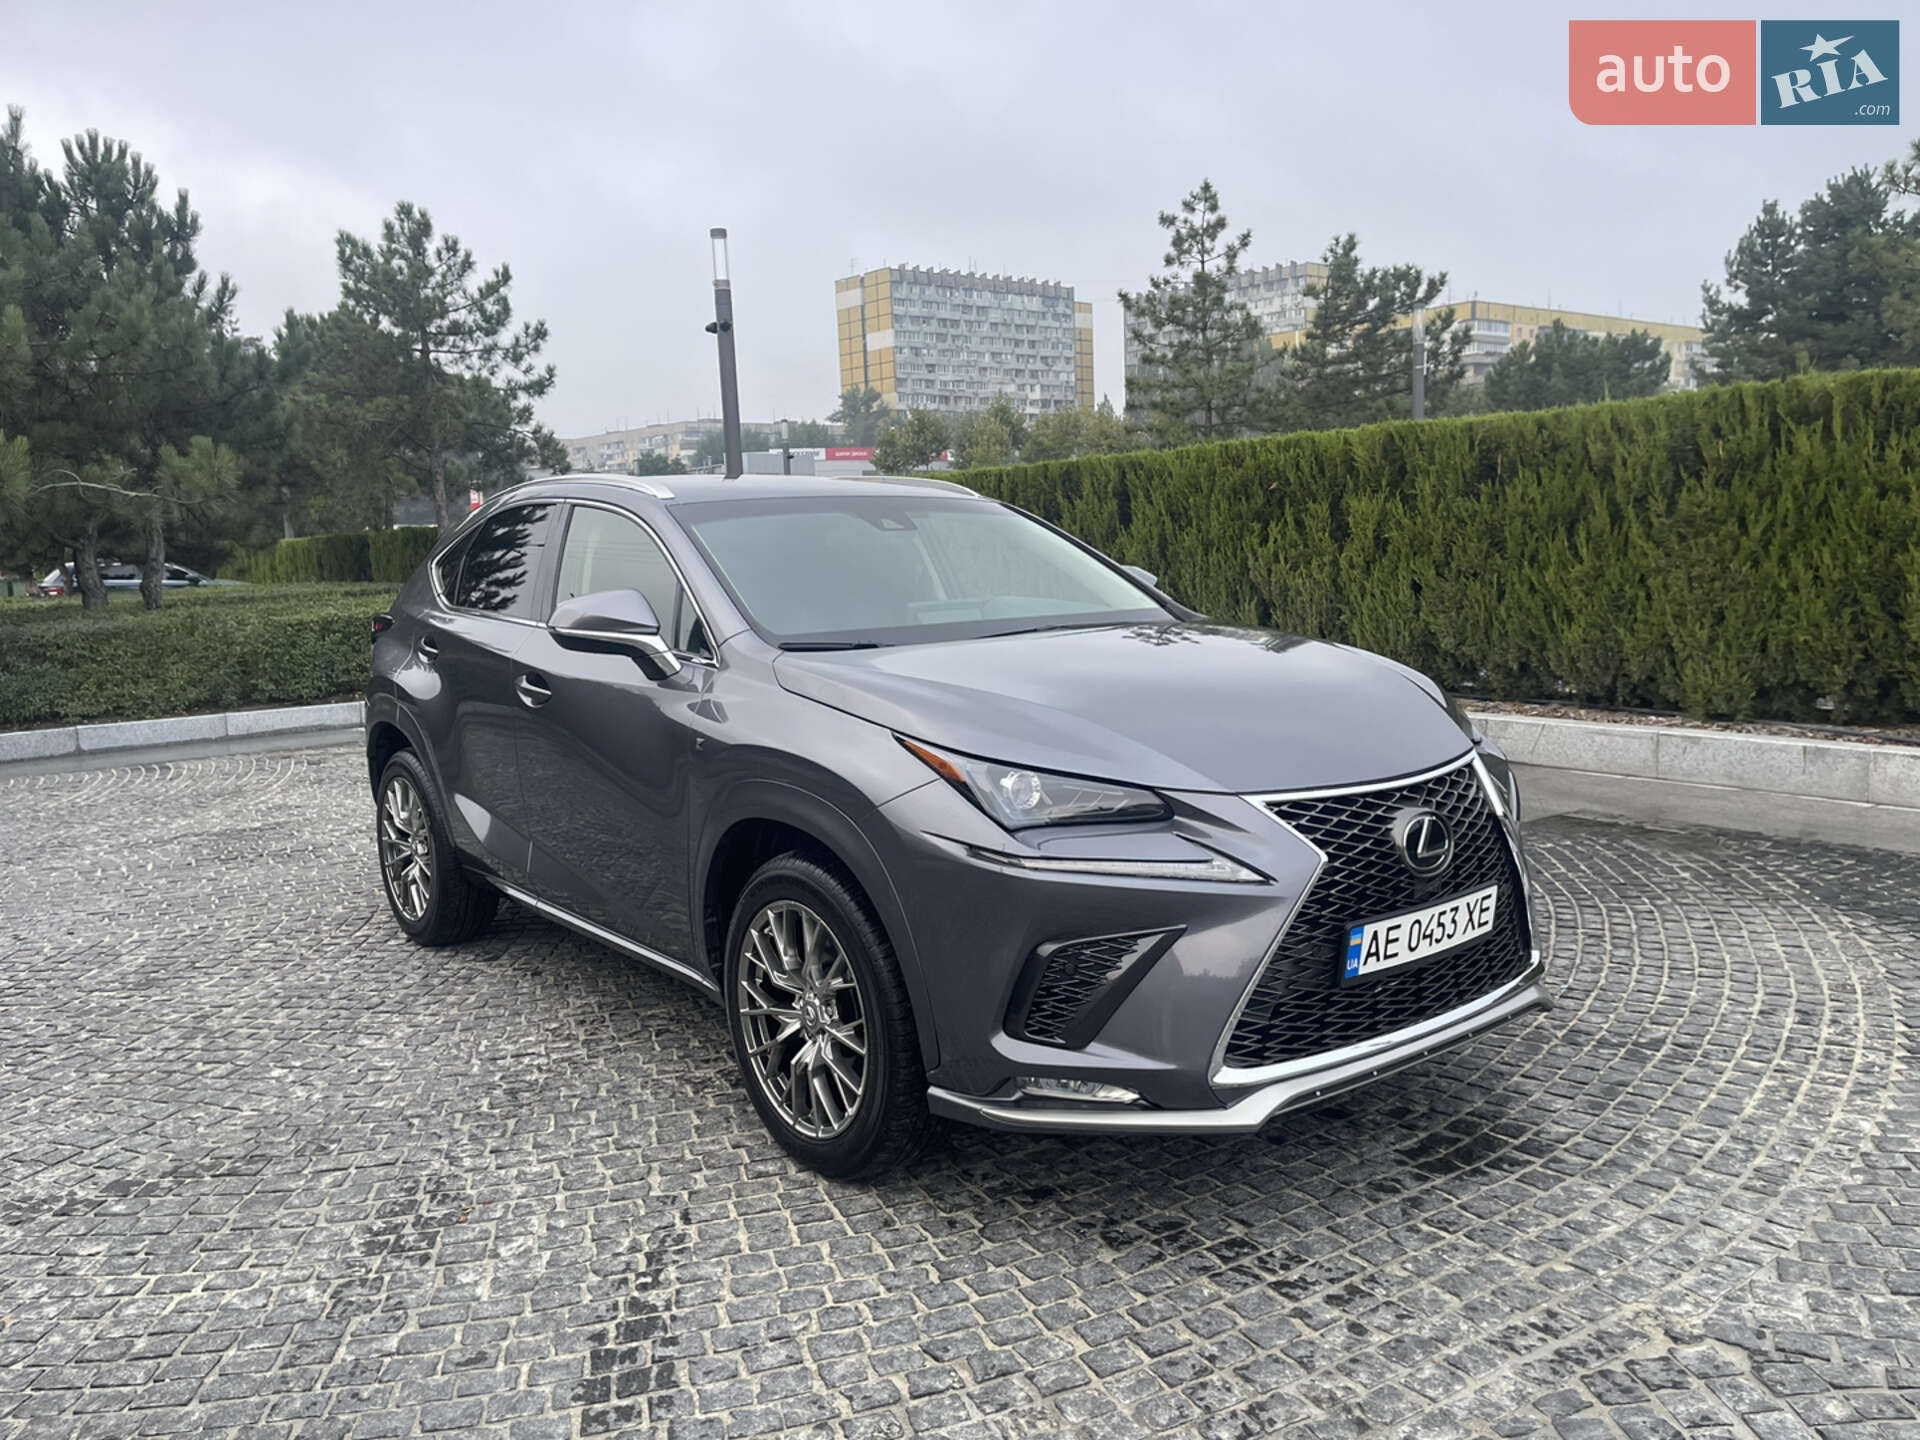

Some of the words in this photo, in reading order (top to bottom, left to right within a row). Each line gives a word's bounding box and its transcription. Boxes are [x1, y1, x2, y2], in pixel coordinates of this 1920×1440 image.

[1363, 924, 1402, 966] AE
[1407, 905, 1460, 952] 0453
[1462, 893, 1493, 935] XE
[1346, 958, 1359, 970] UA
